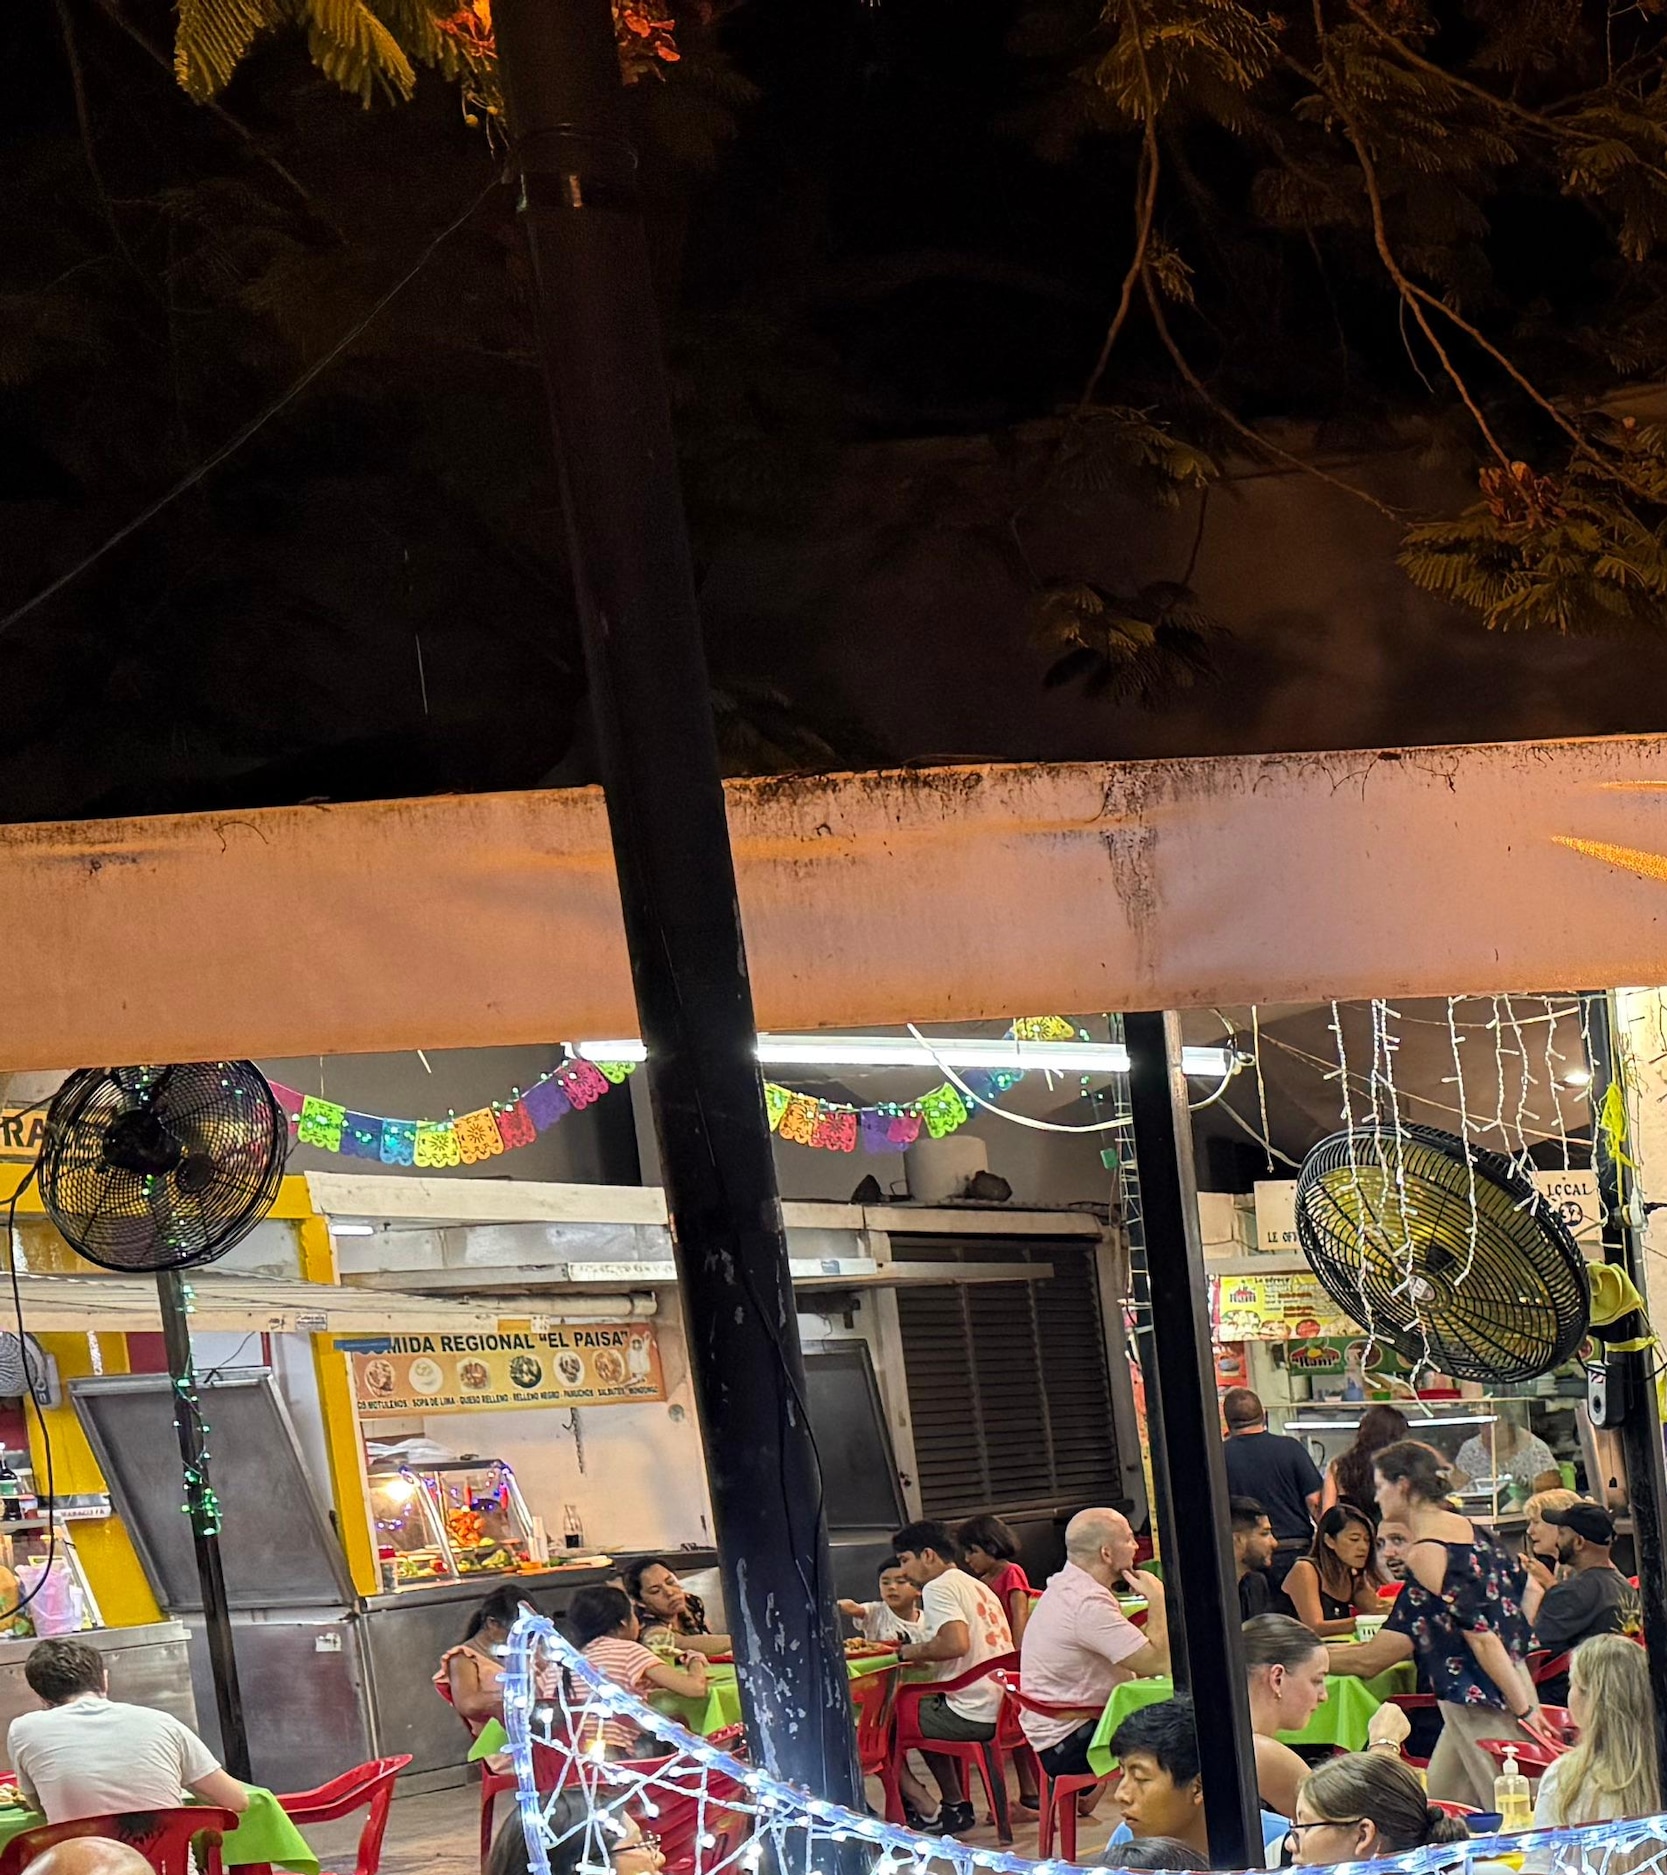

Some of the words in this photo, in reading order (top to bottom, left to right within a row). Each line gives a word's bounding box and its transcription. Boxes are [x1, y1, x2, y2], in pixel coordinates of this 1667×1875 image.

[1546, 1183, 1588, 1197] LOCAL
[368, 1335, 436, 1354] MIDA
[441, 1332, 536, 1352] REGIONAL
